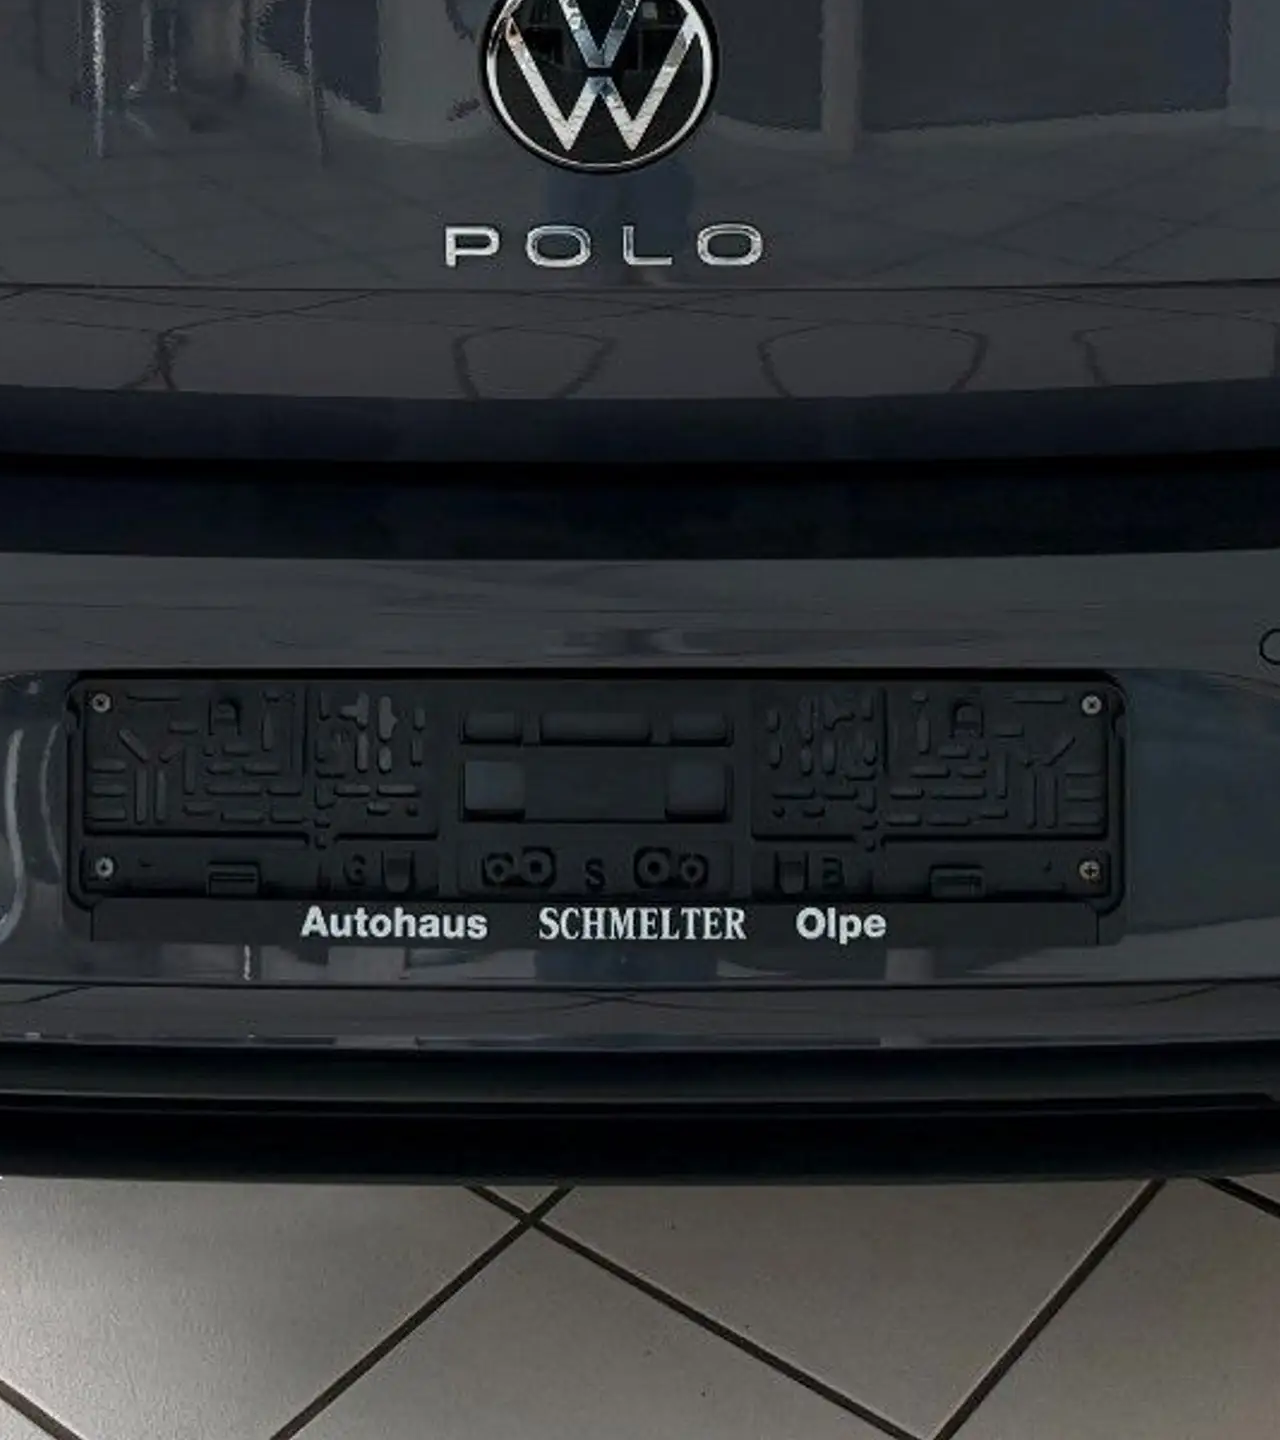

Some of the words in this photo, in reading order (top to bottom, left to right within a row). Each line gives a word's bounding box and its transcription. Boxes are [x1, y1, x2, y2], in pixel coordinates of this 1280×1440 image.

[444, 222, 764, 269] POLO
[585, 858, 606, 890] S
[301, 906, 488, 939] Autohaus
[538, 907, 747, 940] SCHMELTER
[795, 907, 887, 944] Olpe
